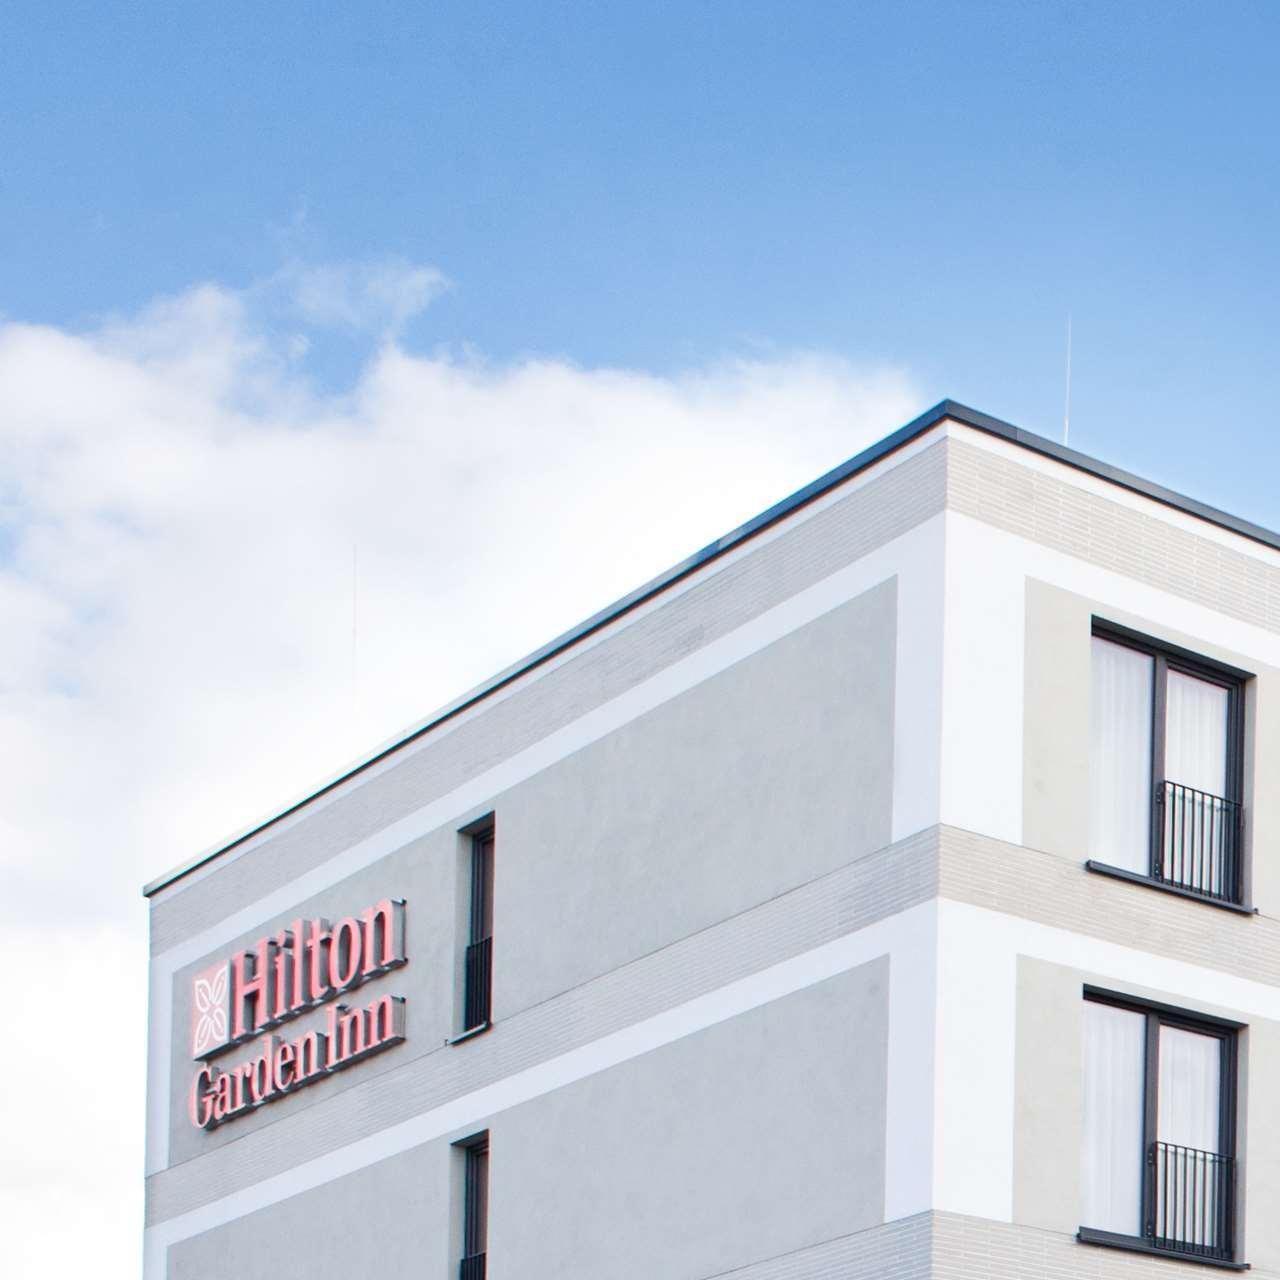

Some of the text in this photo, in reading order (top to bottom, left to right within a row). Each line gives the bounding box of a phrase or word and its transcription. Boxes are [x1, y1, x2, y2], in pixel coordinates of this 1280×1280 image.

[231, 898, 396, 1040] Hilton
[189, 994, 396, 1129] Garden Inn
